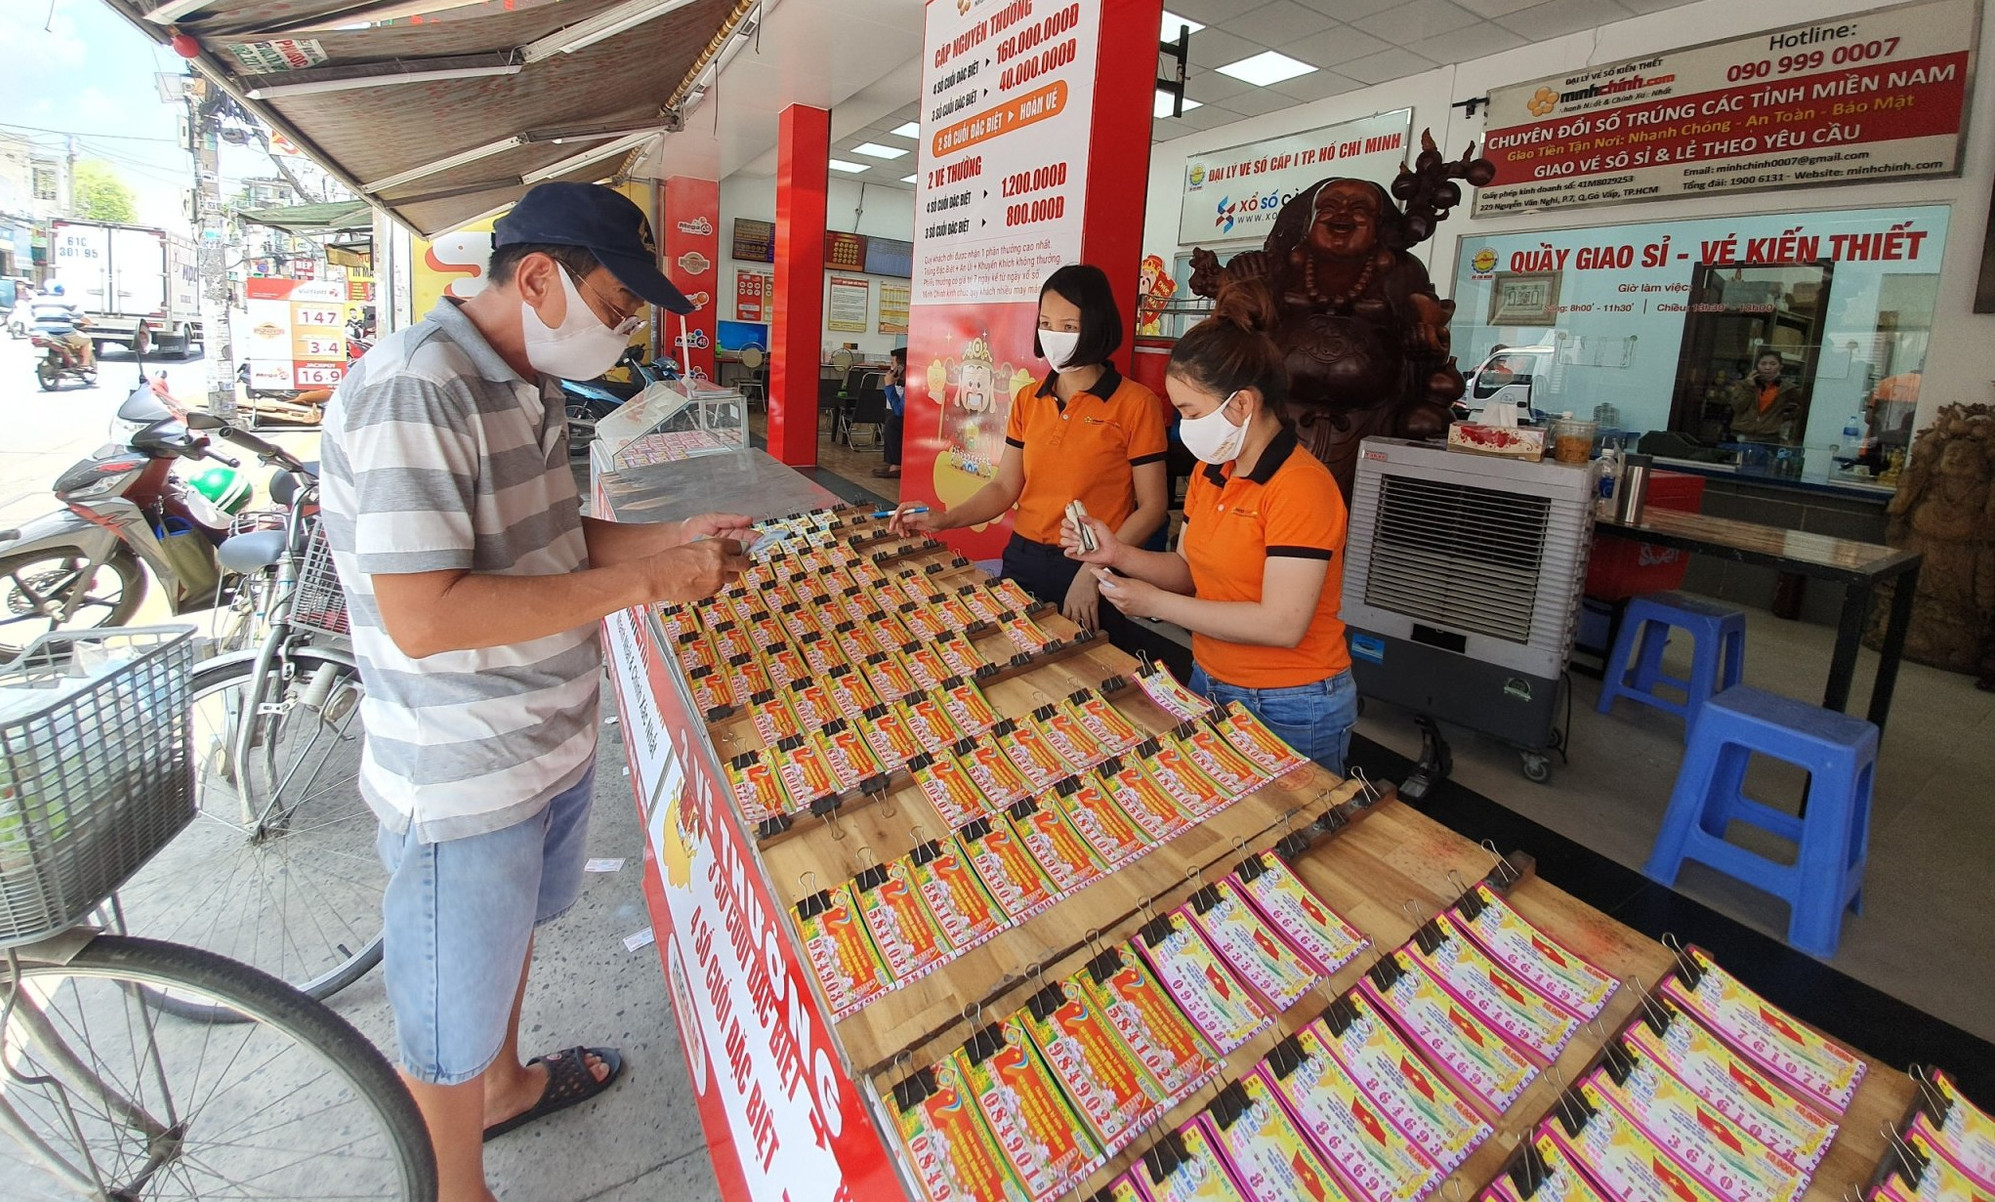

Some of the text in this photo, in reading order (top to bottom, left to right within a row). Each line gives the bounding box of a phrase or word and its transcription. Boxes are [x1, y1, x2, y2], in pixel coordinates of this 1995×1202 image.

[953, 20, 988, 59] NGUYÊN
[996, 3, 1080, 65] 160.000.000Đ
[1726, 36, 1901, 83] 090 999 0007
[1769, 23, 1858, 51] Hotline:
[999, 38, 1077, 92] 40.000.000Đ
[937, 140, 943, 151] 2
[1019, 95, 1044, 121] HOÀN
[1045, 87, 1058, 111] VÉ
[1488, 127, 1553, 151] CHUYÊN
[1557, 116, 1591, 140] ĐỔI
[1595, 110, 1622, 131] SỐ
[1626, 100, 1696, 128] TRÚNG
[1701, 94, 1744, 116] CÁC
[1750, 83, 1805, 108] TỈNH
[1812, 72, 1880, 98] MIỀN
[1887, 63, 1956, 88] NAM
[1507, 149, 1535, 162] Giao
[1568, 140, 1591, 154] Tận
[1628, 128, 1677, 144] Nhanh
[1682, 119, 1731, 138] Chóng
[1745, 114, 1769, 129] An
[1774, 107, 1816, 123] Toàn
[1874, 93, 1916, 112] Mật
[928, 171, 933, 190] 2
[934, 163, 945, 188] VÉ
[1208, 167, 1224, 185] ĐẠI
[1225, 162, 1238, 179] LÝ
[1239, 160, 1251, 177] VÉ
[1253, 155, 1268, 174] SỐ
[1270, 150, 1291, 172] CẤP
[1301, 149, 1315, 166] TP.
[1318, 141, 1335, 162] HỒ
[1339, 137, 1362, 158] CHÍ
[1364, 132, 1402, 154] MINH
[1533, 162, 1574, 179] GIAO
[1579, 156, 1601, 173] VÉ
[1632, 146, 1650, 165] SỈ
[1655, 147, 1670, 162] &
[1675, 140, 1697, 160] LẺ
[1702, 136, 1758, 157] THEO
[1763, 127, 1806, 149] YÊU
[1812, 122, 1862, 144] CẦU
[1683, 150, 1870, 177] Email: minhchinh0007@gmail.com
[1730, 175, 1756, 187] 1900
[1758, 173, 1784, 184] 6131
[1794, 168, 1845, 180] Website:
[1846, 160, 1944, 177] minhchinh.com
[1001, 161, 1067, 198] 1.200.000Đ
[1240, 189, 1279, 213] XỔ SỐ
[1006, 195, 1065, 227] 800.000Đ
[84, 248, 98, 259] 95
[1510, 220, 1928, 275] QUẦY GIAO SỈ VÉ KIẾN THIẾT
[1618, 282, 1638, 293] Giờ
[1640, 283, 1661, 293] làm
[302, 311, 337, 324] 147
[311, 342, 339, 354] 3.4
[302, 370, 340, 382] 16.9
[681, 727, 689, 773] 2
[975, 855, 1016, 908] 984904
[868, 910, 902, 969] 584103
[808, 938, 845, 1003] 984903
[1222, 942, 1282, 999] 833598
[1171, 979, 1226, 1042] 095098
[690, 904, 780, 1175] 4 SỐ CUỐI ĐẶC BIỆT
[1107, 1008, 1170, 1081] 584102
[1048, 1041, 1111, 1127] 984902
[983, 1091, 1039, 1183] 084901
[1365, 1078, 1444, 1156] 864693
